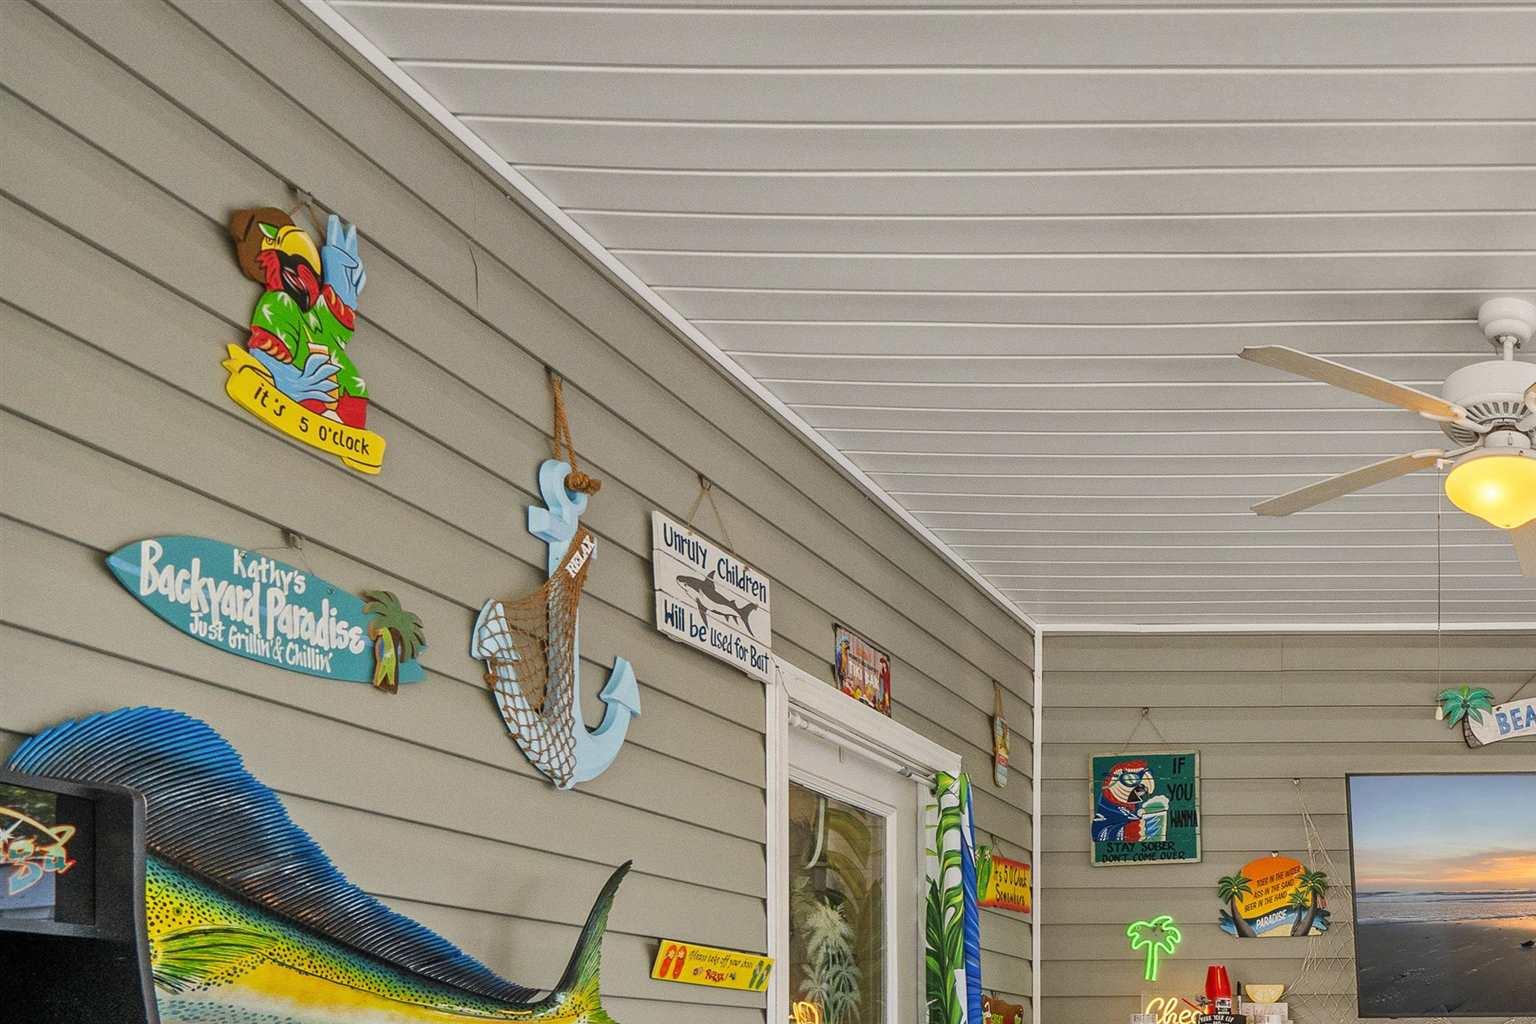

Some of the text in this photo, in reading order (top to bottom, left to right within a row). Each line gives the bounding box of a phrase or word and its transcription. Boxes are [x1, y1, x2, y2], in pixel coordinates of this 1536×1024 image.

[253, 383, 286, 417] it's
[299, 418, 309, 434] 5
[233, 548, 306, 595] Kathy's
[565, 535, 596, 579] RELAX
[663, 523, 767, 604] Unruly Children
[139, 539, 365, 655] Backyard Paradise
[189, 611, 226, 642] Just
[271, 637, 284, 661] &
[285, 645, 333, 673] Chillin'
[664, 599, 686, 632] Will
[689, 613, 708, 642] be
[710, 627, 733, 654] used
[734, 637, 749, 662] for
[1172, 757, 1186, 774] IF
[1168, 783, 1194, 801] YOU
[1106, 841, 1175, 853] STAY SOBER
[1133, 852, 1157, 862] COME
[1160, 851, 1186, 861] OVER
[1256, 909, 1288, 928] PARADISE
